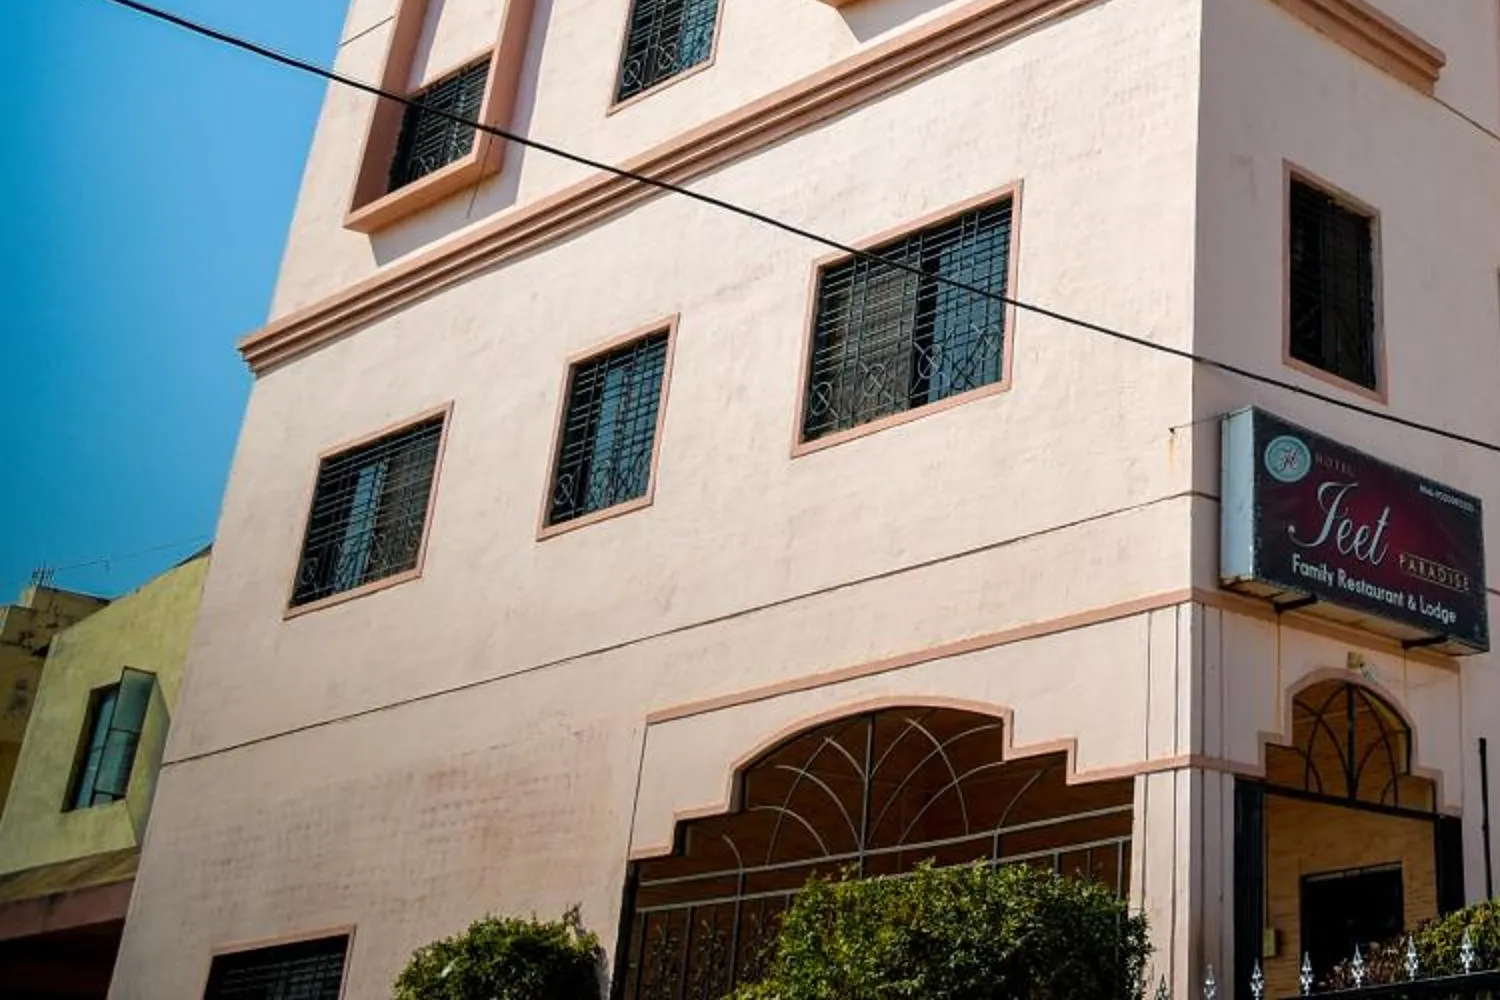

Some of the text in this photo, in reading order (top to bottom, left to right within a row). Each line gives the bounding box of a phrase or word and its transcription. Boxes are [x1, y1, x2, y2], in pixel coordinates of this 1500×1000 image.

[1315, 453, 1354, 476] HOTEL
[1292, 553, 1456, 625] Family Restaurant & Lodge
[1399, 554, 1471, 591] PARADISE
